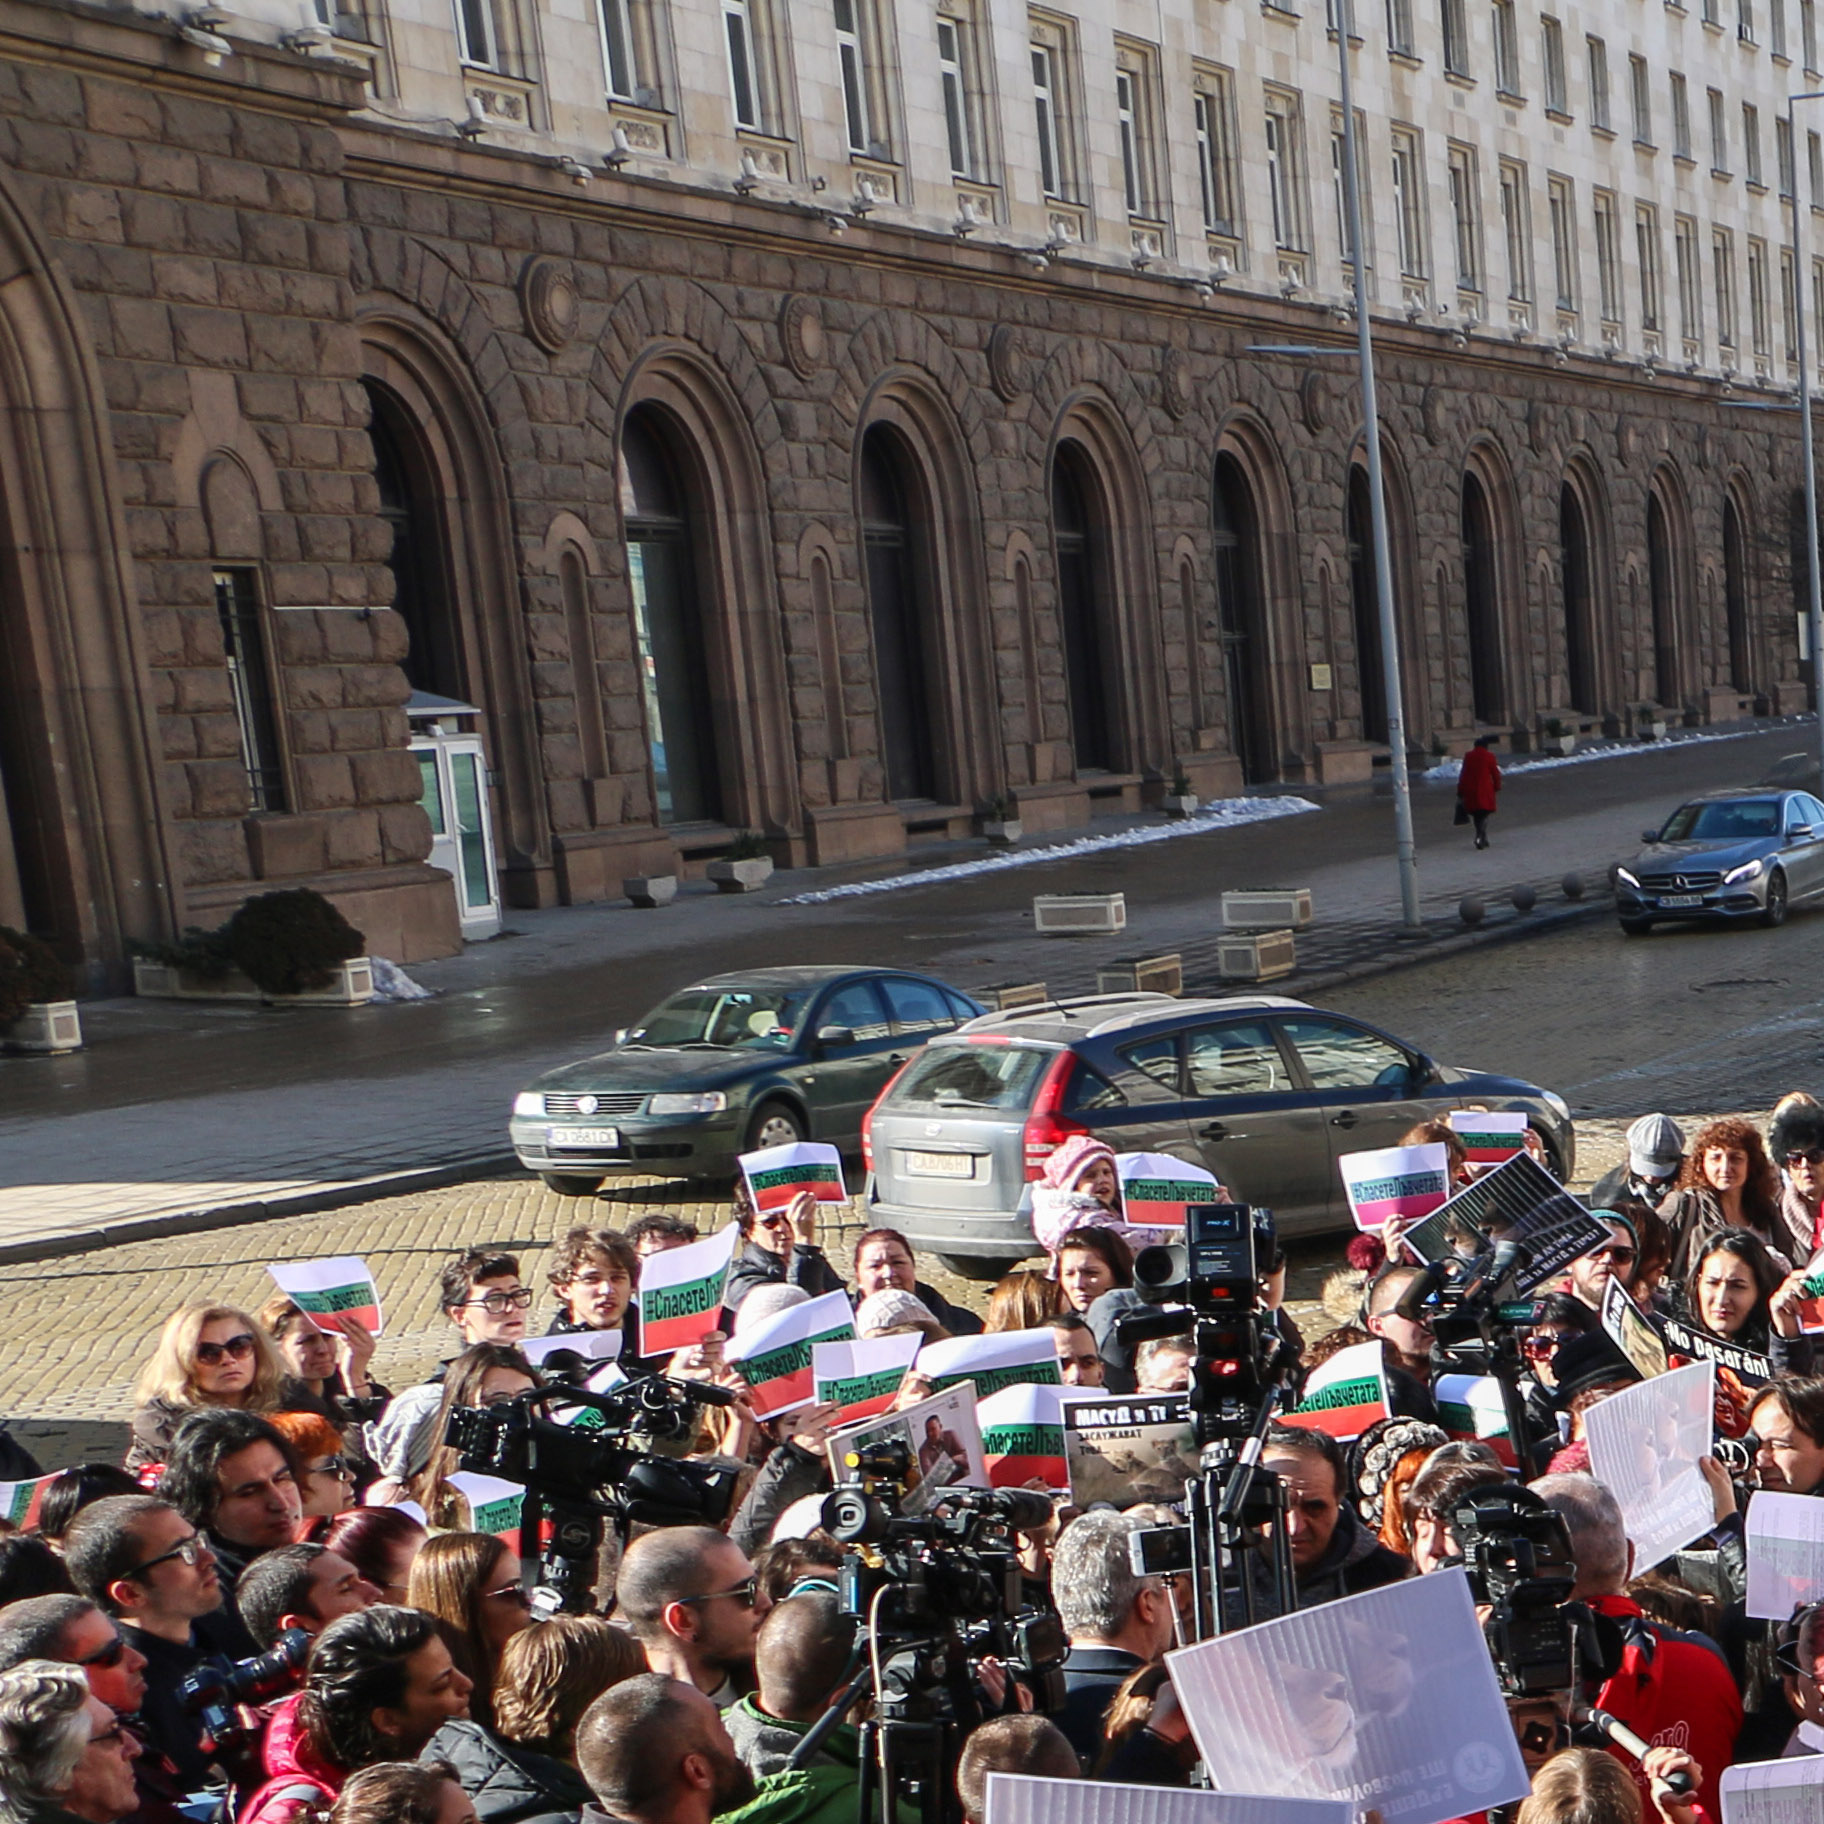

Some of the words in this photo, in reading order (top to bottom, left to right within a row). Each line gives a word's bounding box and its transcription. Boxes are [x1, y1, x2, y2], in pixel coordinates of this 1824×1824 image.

[1663, 1321, 1692, 1350] ¡No
[1694, 1340, 1771, 1380] pasarán!
[1074, 1408, 1130, 1427] МАСУД
